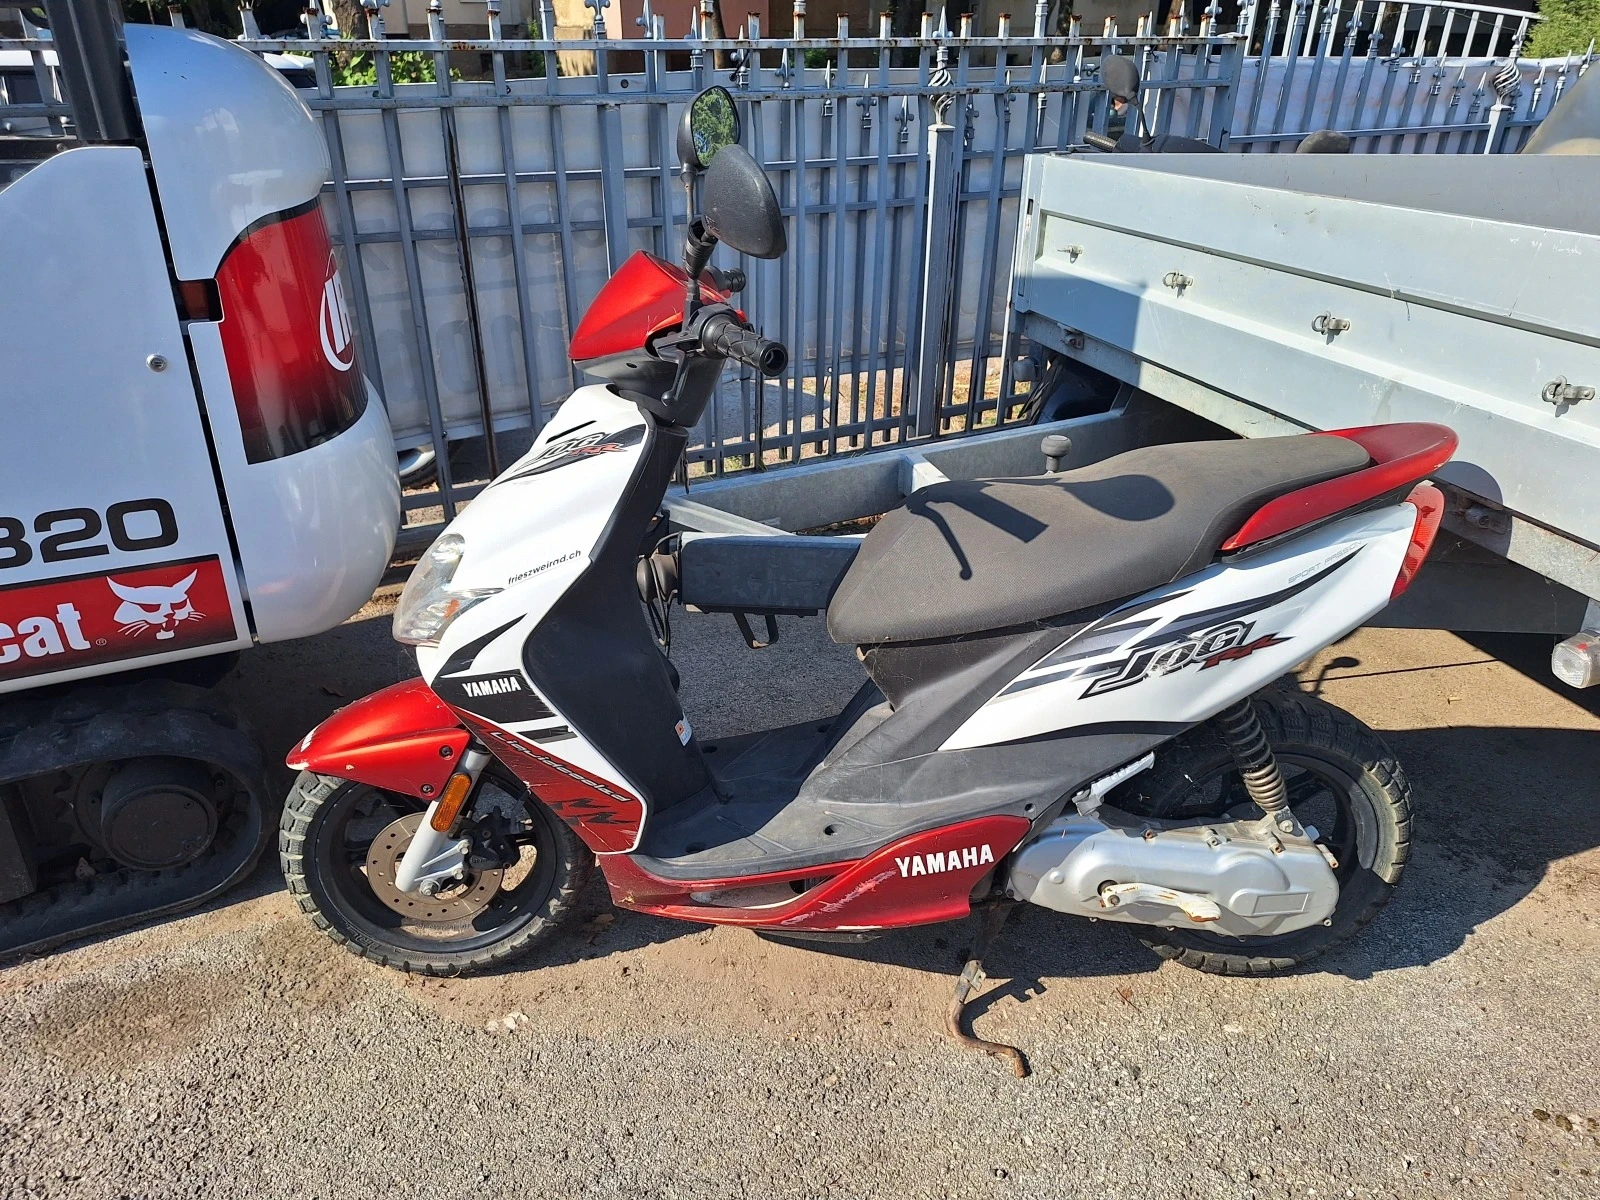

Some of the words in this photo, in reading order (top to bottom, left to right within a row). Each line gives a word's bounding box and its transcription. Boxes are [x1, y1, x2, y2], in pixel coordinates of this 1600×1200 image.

[508, 550, 582, 585] frieszweirad.ch
[1288, 562, 1322, 584] SPORT
[1078, 620, 1256, 700] JOG
[462, 676, 521, 698] YAMAHA
[894, 843, 995, 878] YAMAHA
